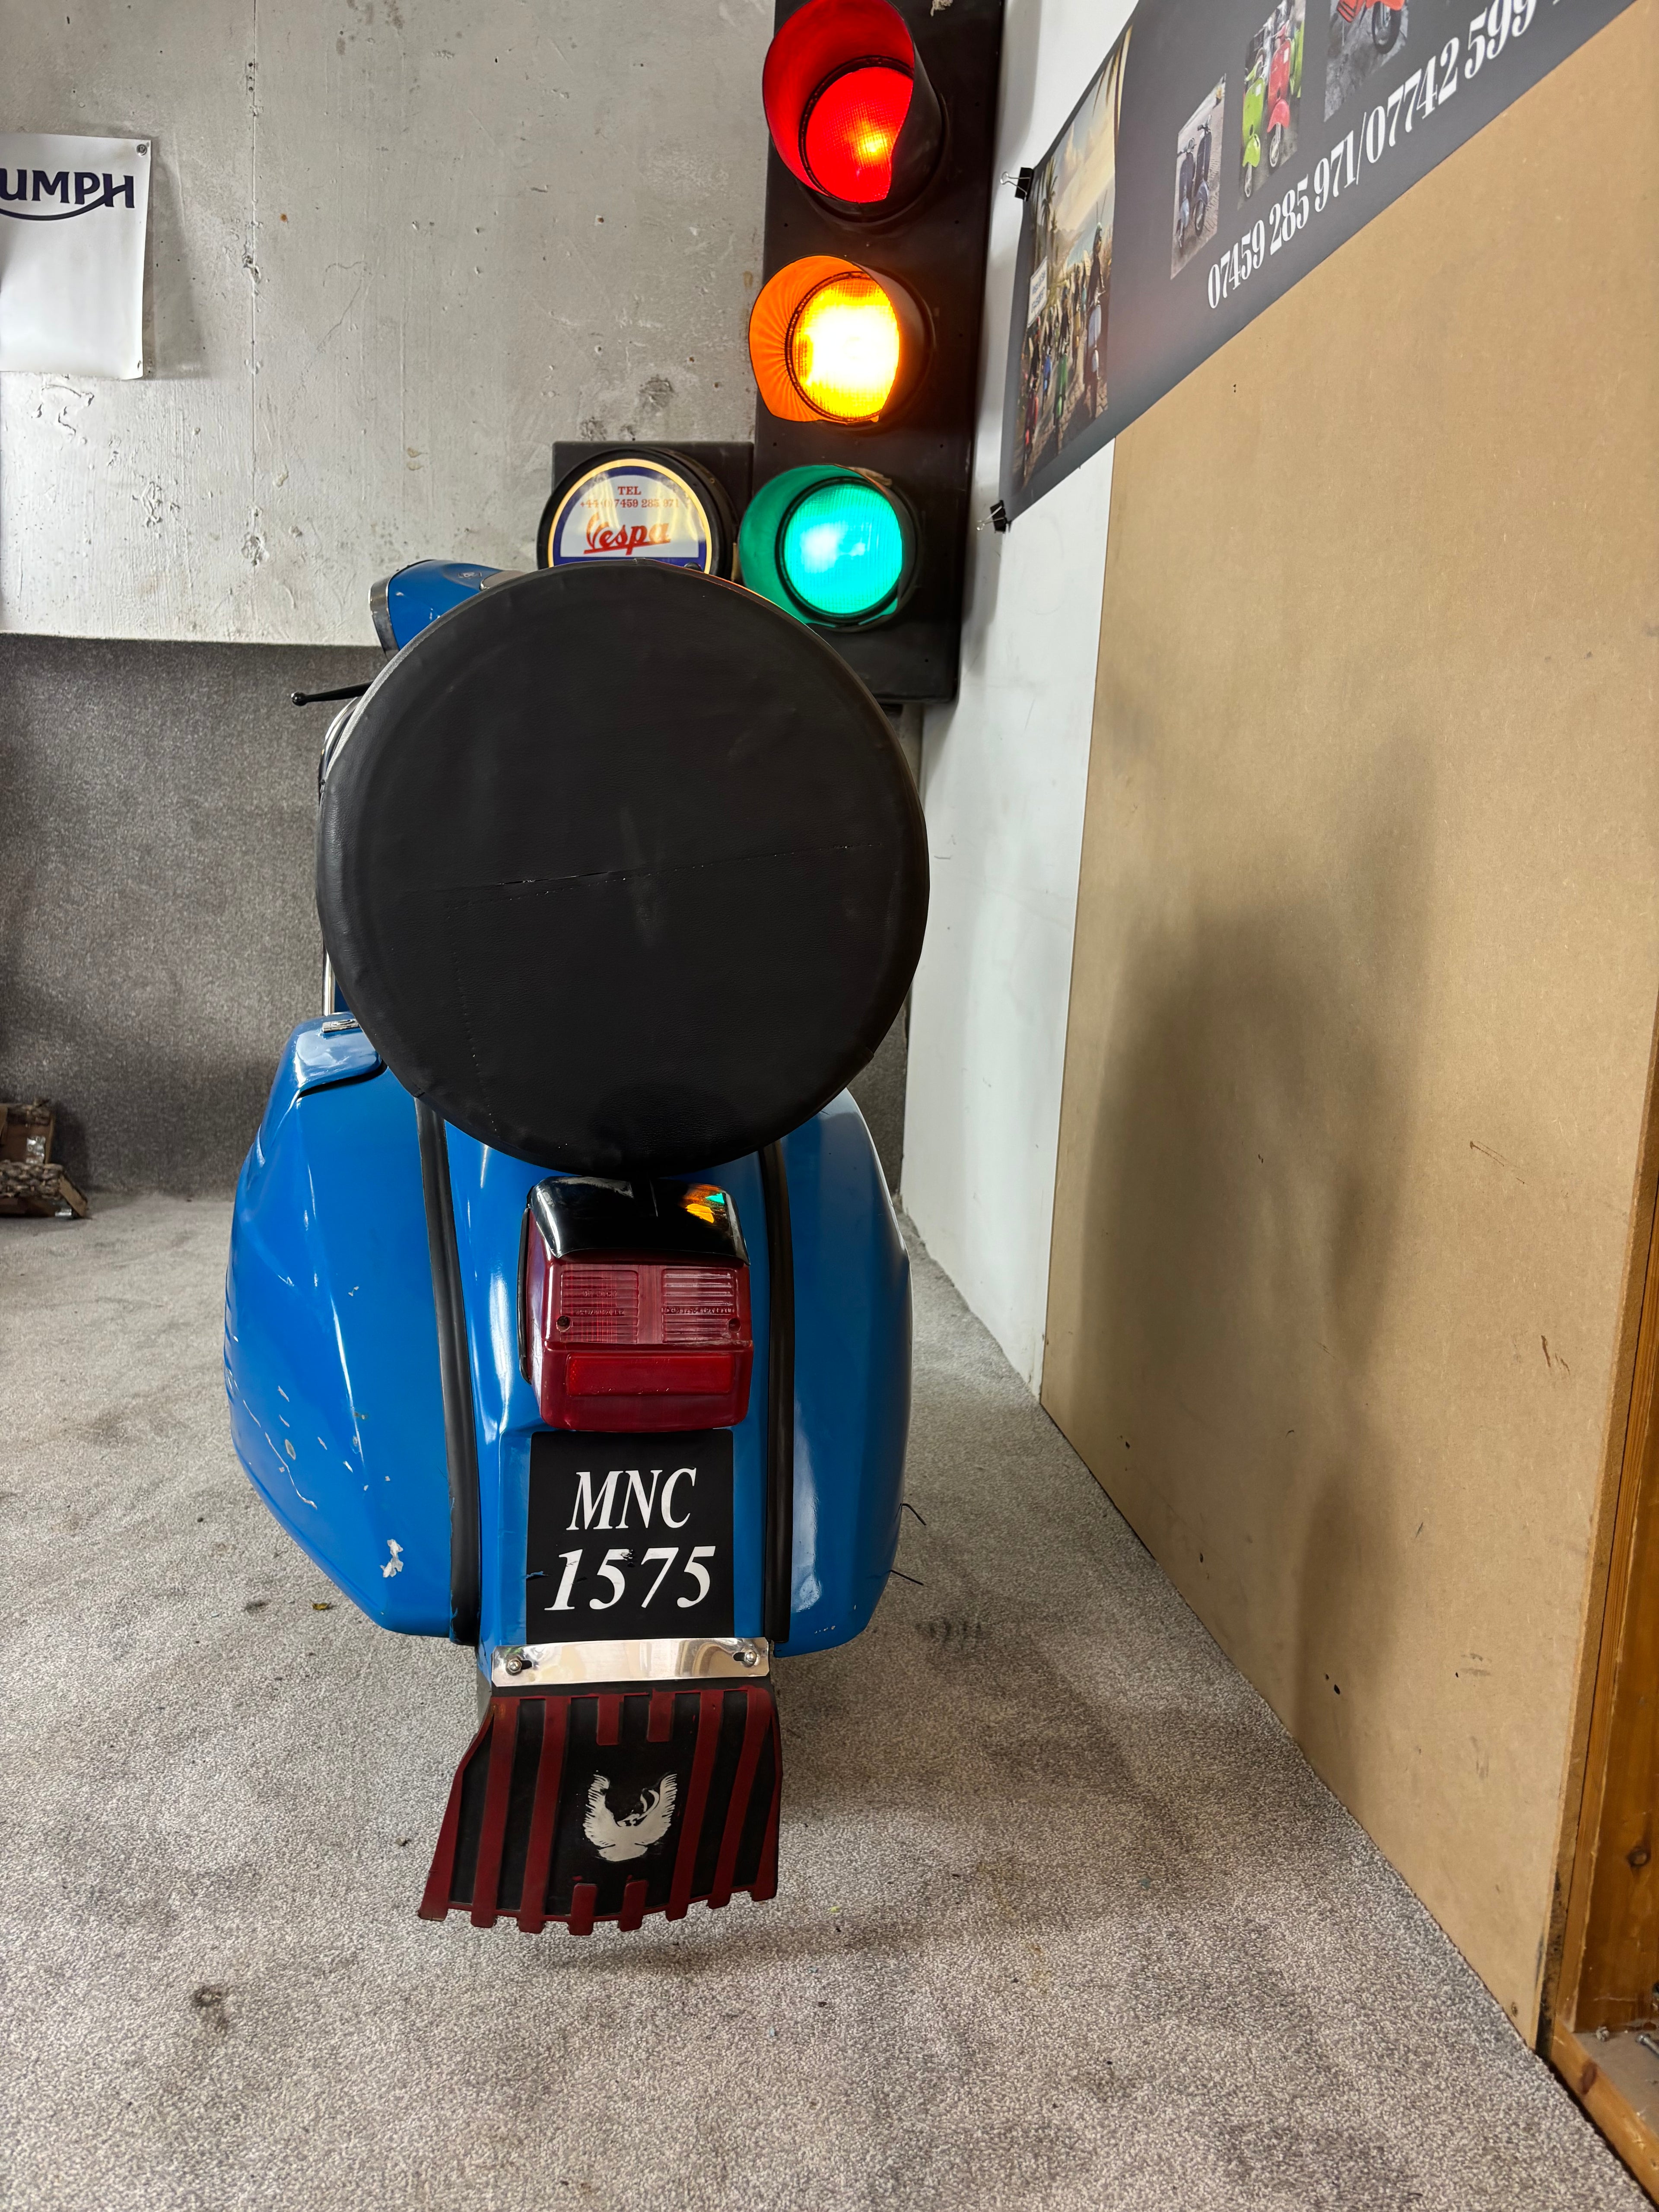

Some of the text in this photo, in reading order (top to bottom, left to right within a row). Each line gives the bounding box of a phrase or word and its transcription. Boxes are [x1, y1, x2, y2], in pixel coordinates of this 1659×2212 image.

[1207, 219, 1265, 309] 07459
[1269, 174, 1310, 256] 285
[617, 486, 642, 495] TEL
[641, 499, 660, 508] 285
[663, 499, 679, 508] 971
[583, 512, 671, 556] Vespa
[566, 1467, 697, 1530] MNC
[544, 1545, 716, 1611] 1575
